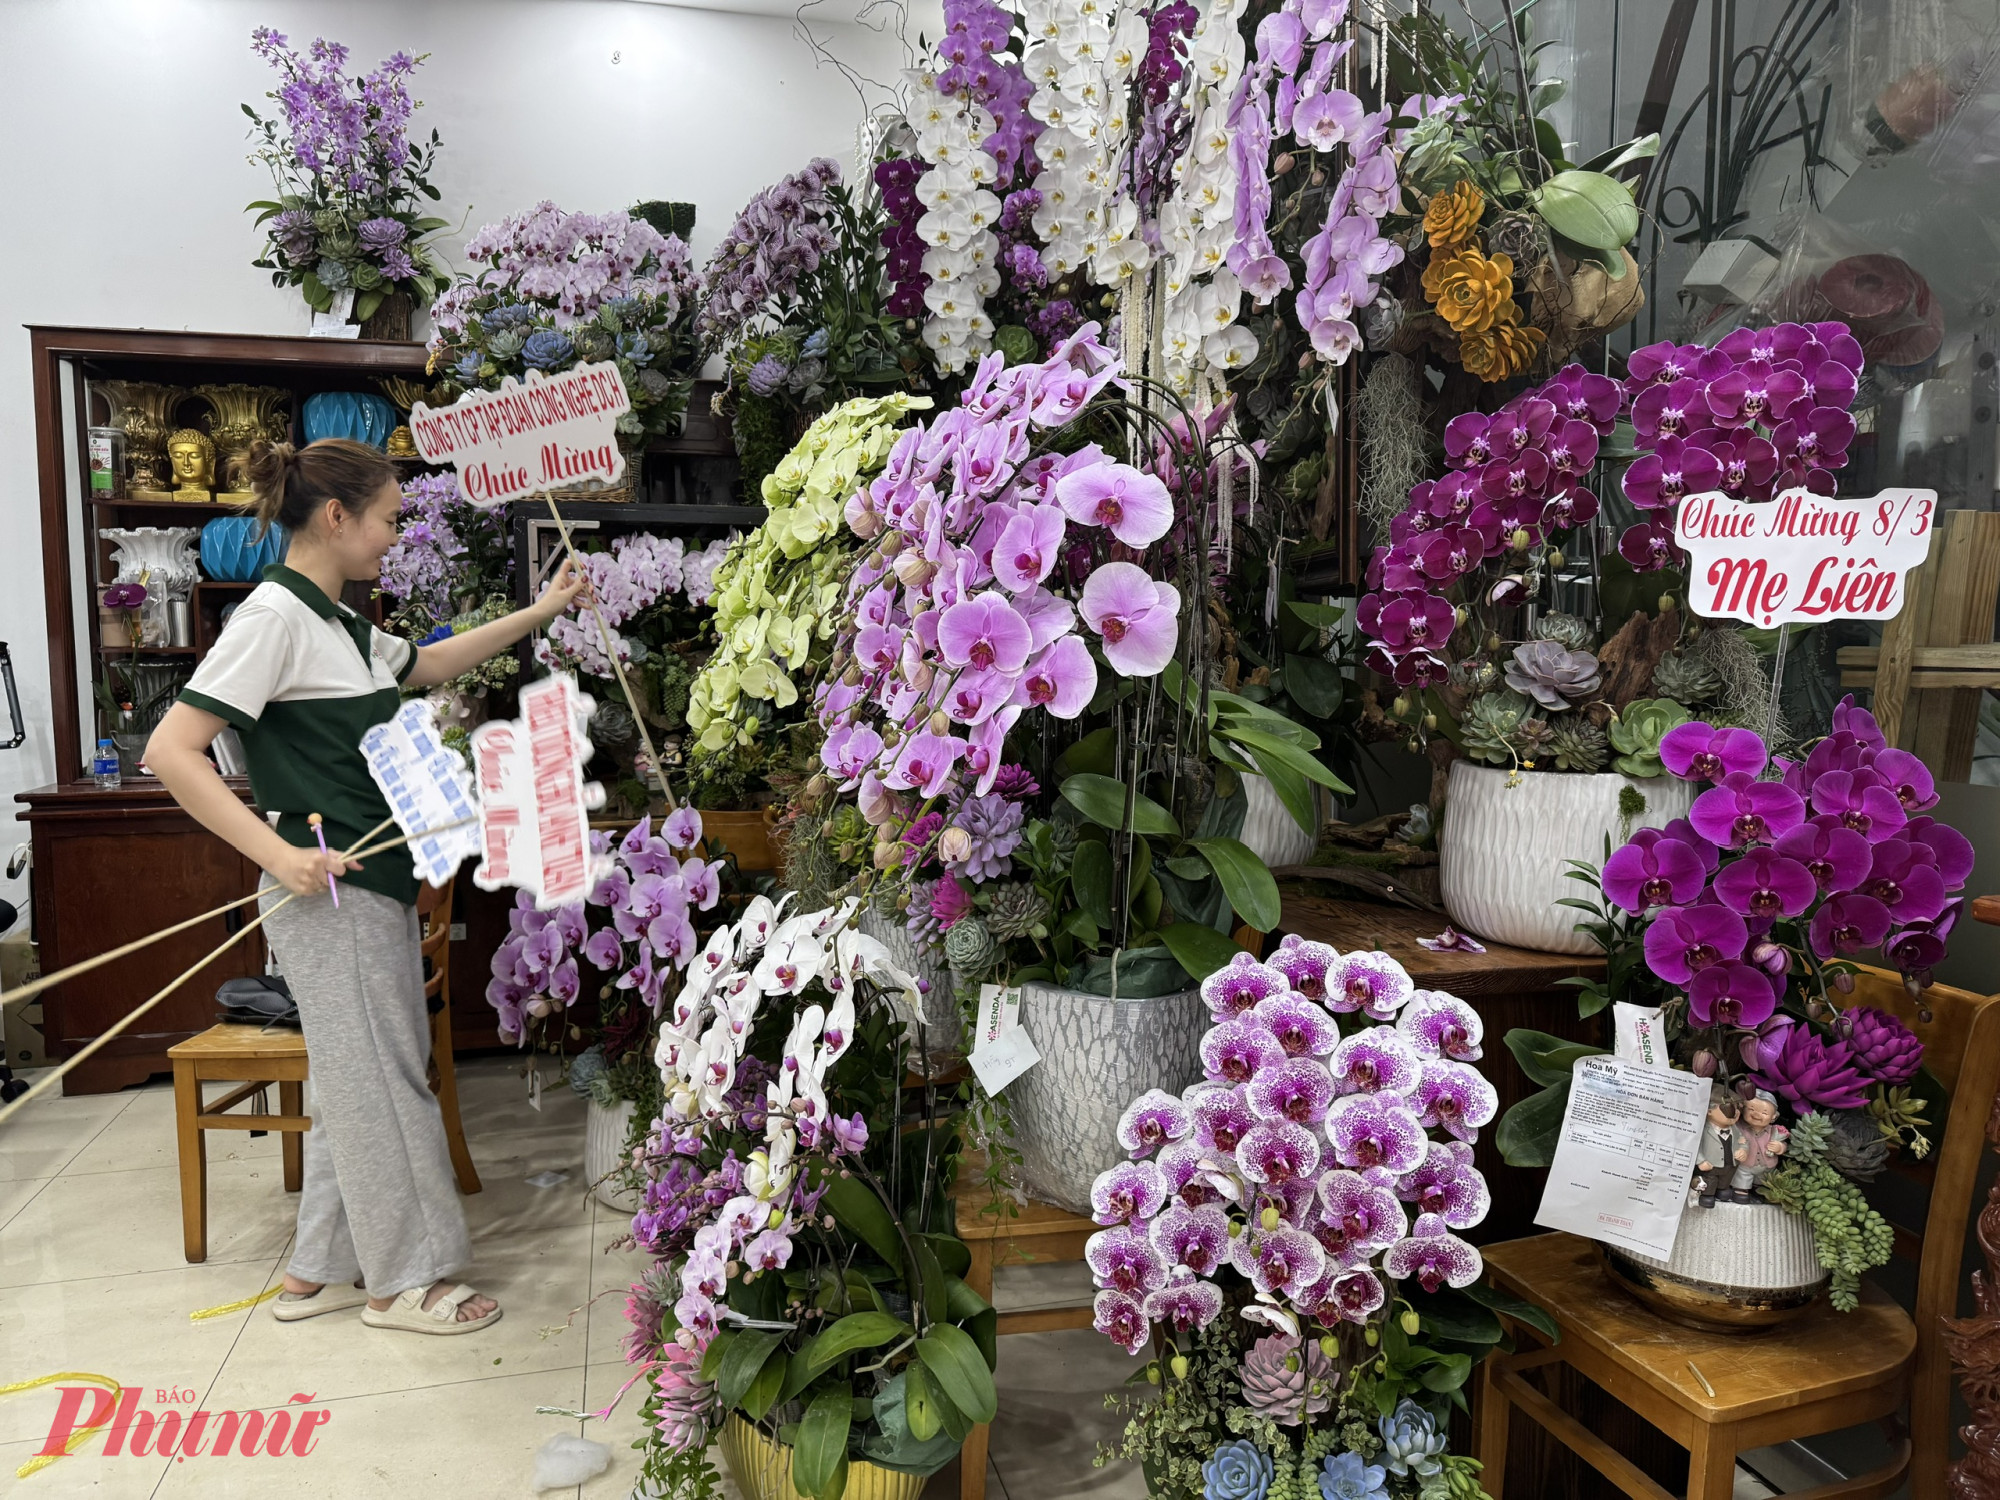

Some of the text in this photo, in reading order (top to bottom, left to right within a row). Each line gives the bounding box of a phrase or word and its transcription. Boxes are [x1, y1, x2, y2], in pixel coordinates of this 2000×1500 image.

[415, 369, 625, 458] CÔNG TY CP TẬP ĐOÀN CÔNG NGHỆ DCH
[464, 442, 617, 501] Chúc Mừng
[1681, 494, 1932, 546] Chúc Mừng 8/3
[1707, 556, 1897, 626] Mẹ Liên
[1585, 1060, 1603, 1071] Hoa
[1605, 1065, 1618, 1076] Mỹ
